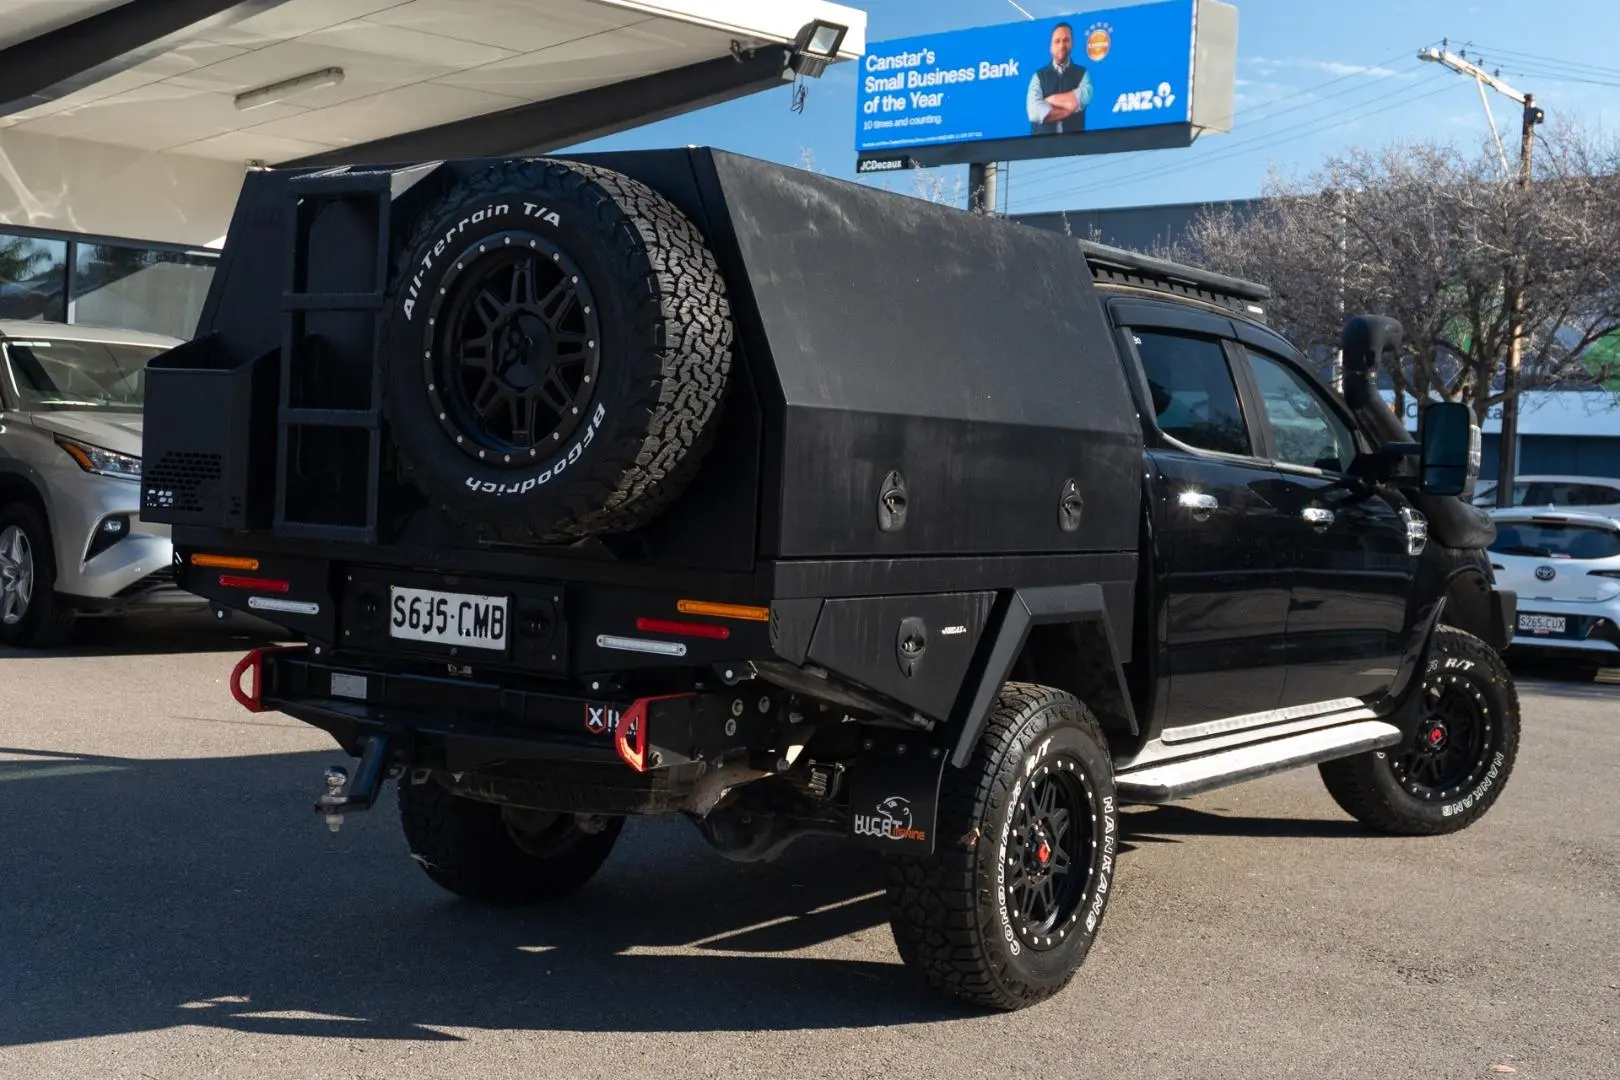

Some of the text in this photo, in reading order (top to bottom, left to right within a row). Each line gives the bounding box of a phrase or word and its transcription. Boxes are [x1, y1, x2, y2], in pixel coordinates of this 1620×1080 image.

[865, 48, 936, 72] Canstar's
[864, 58, 1019, 93] Small Business Bank
[863, 91, 944, 114] of the Year
[1112, 90, 1154, 113] ANZ
[863, 121, 873, 130] 10
[874, 119, 893, 129] times
[894, 117, 908, 127] and
[860, 160, 902, 171] JCDecaux
[403, 202, 560, 320] All-Terrain T/A
[465, 402, 605, 496] BFGoodrich
[1445, 657, 1475, 671] R/T
[1442, 752, 1505, 817] NANKANG
[1086, 796, 1114, 932] NANKANG
